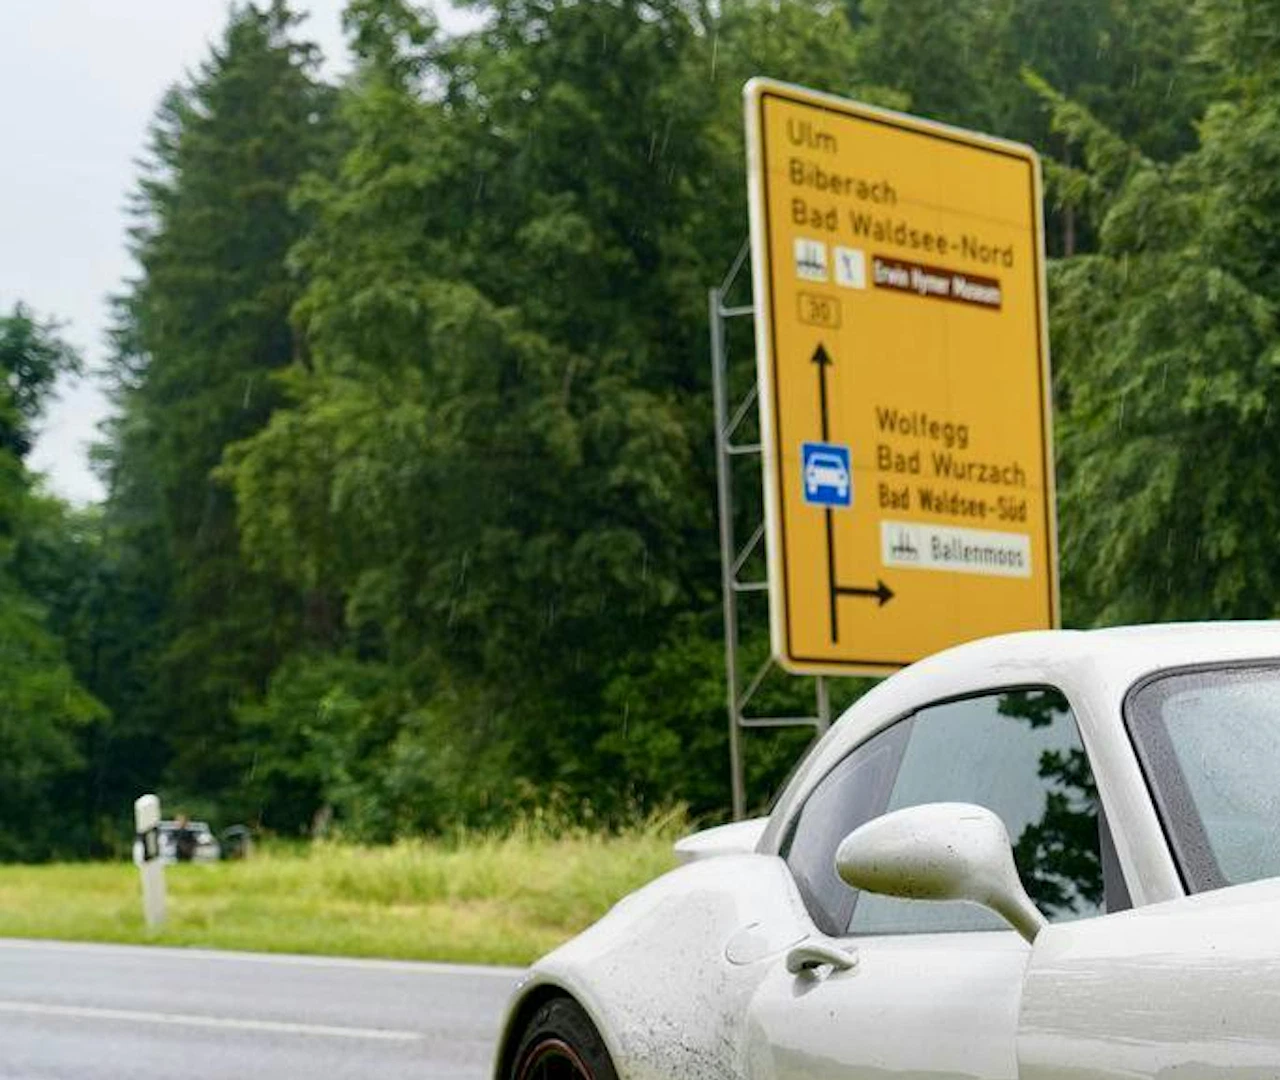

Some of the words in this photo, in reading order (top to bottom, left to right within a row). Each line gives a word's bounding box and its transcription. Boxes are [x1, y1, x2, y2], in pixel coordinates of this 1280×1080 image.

[787, 118, 837, 152] Ulm
[788, 159, 897, 203] Biberach
[791, 199, 839, 232] Bad
[850, 211, 1014, 268] Waldsee-Nord
[876, 405, 969, 449] Wolfegg
[877, 445, 920, 475] Bad
[931, 452, 1026, 486] Wurzach
[879, 483, 909, 511] Bad
[919, 489, 1027, 522] Waldsee-Süd
[931, 535, 1023, 568] Ballenmoos
